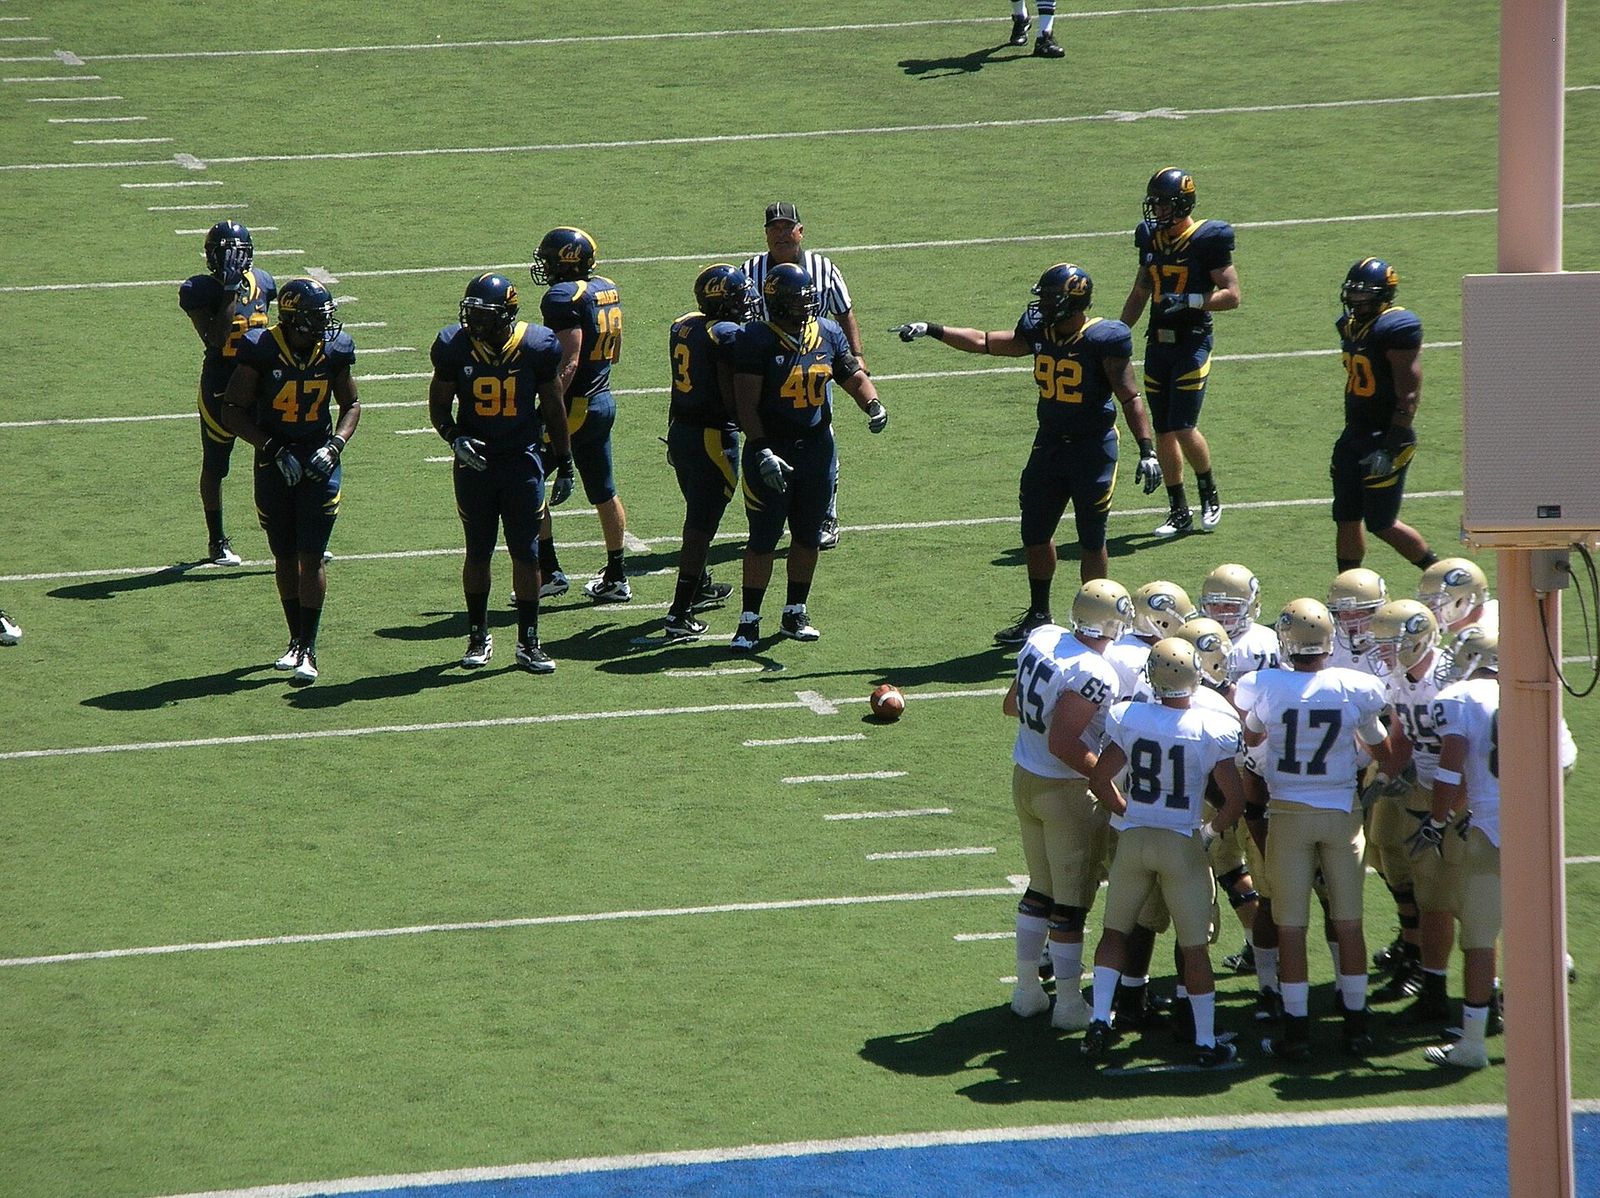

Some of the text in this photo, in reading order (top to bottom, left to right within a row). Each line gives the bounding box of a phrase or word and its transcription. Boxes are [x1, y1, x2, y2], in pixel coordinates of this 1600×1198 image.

[558, 243, 583, 263] Cal
[279, 291, 301, 312] Cal
[704, 277, 729, 298] Cal
[1149, 264, 1188, 304] 17
[674, 343, 693, 393] 3
[780, 363, 833, 408] 40
[1034, 354, 1083, 403] 92
[272, 379, 328, 422] 47
[473, 376, 517, 417] 91
[1080, 677, 1111, 704] 65
[1277, 708, 1342, 775] 17
[1130, 737, 1190, 810] 81
